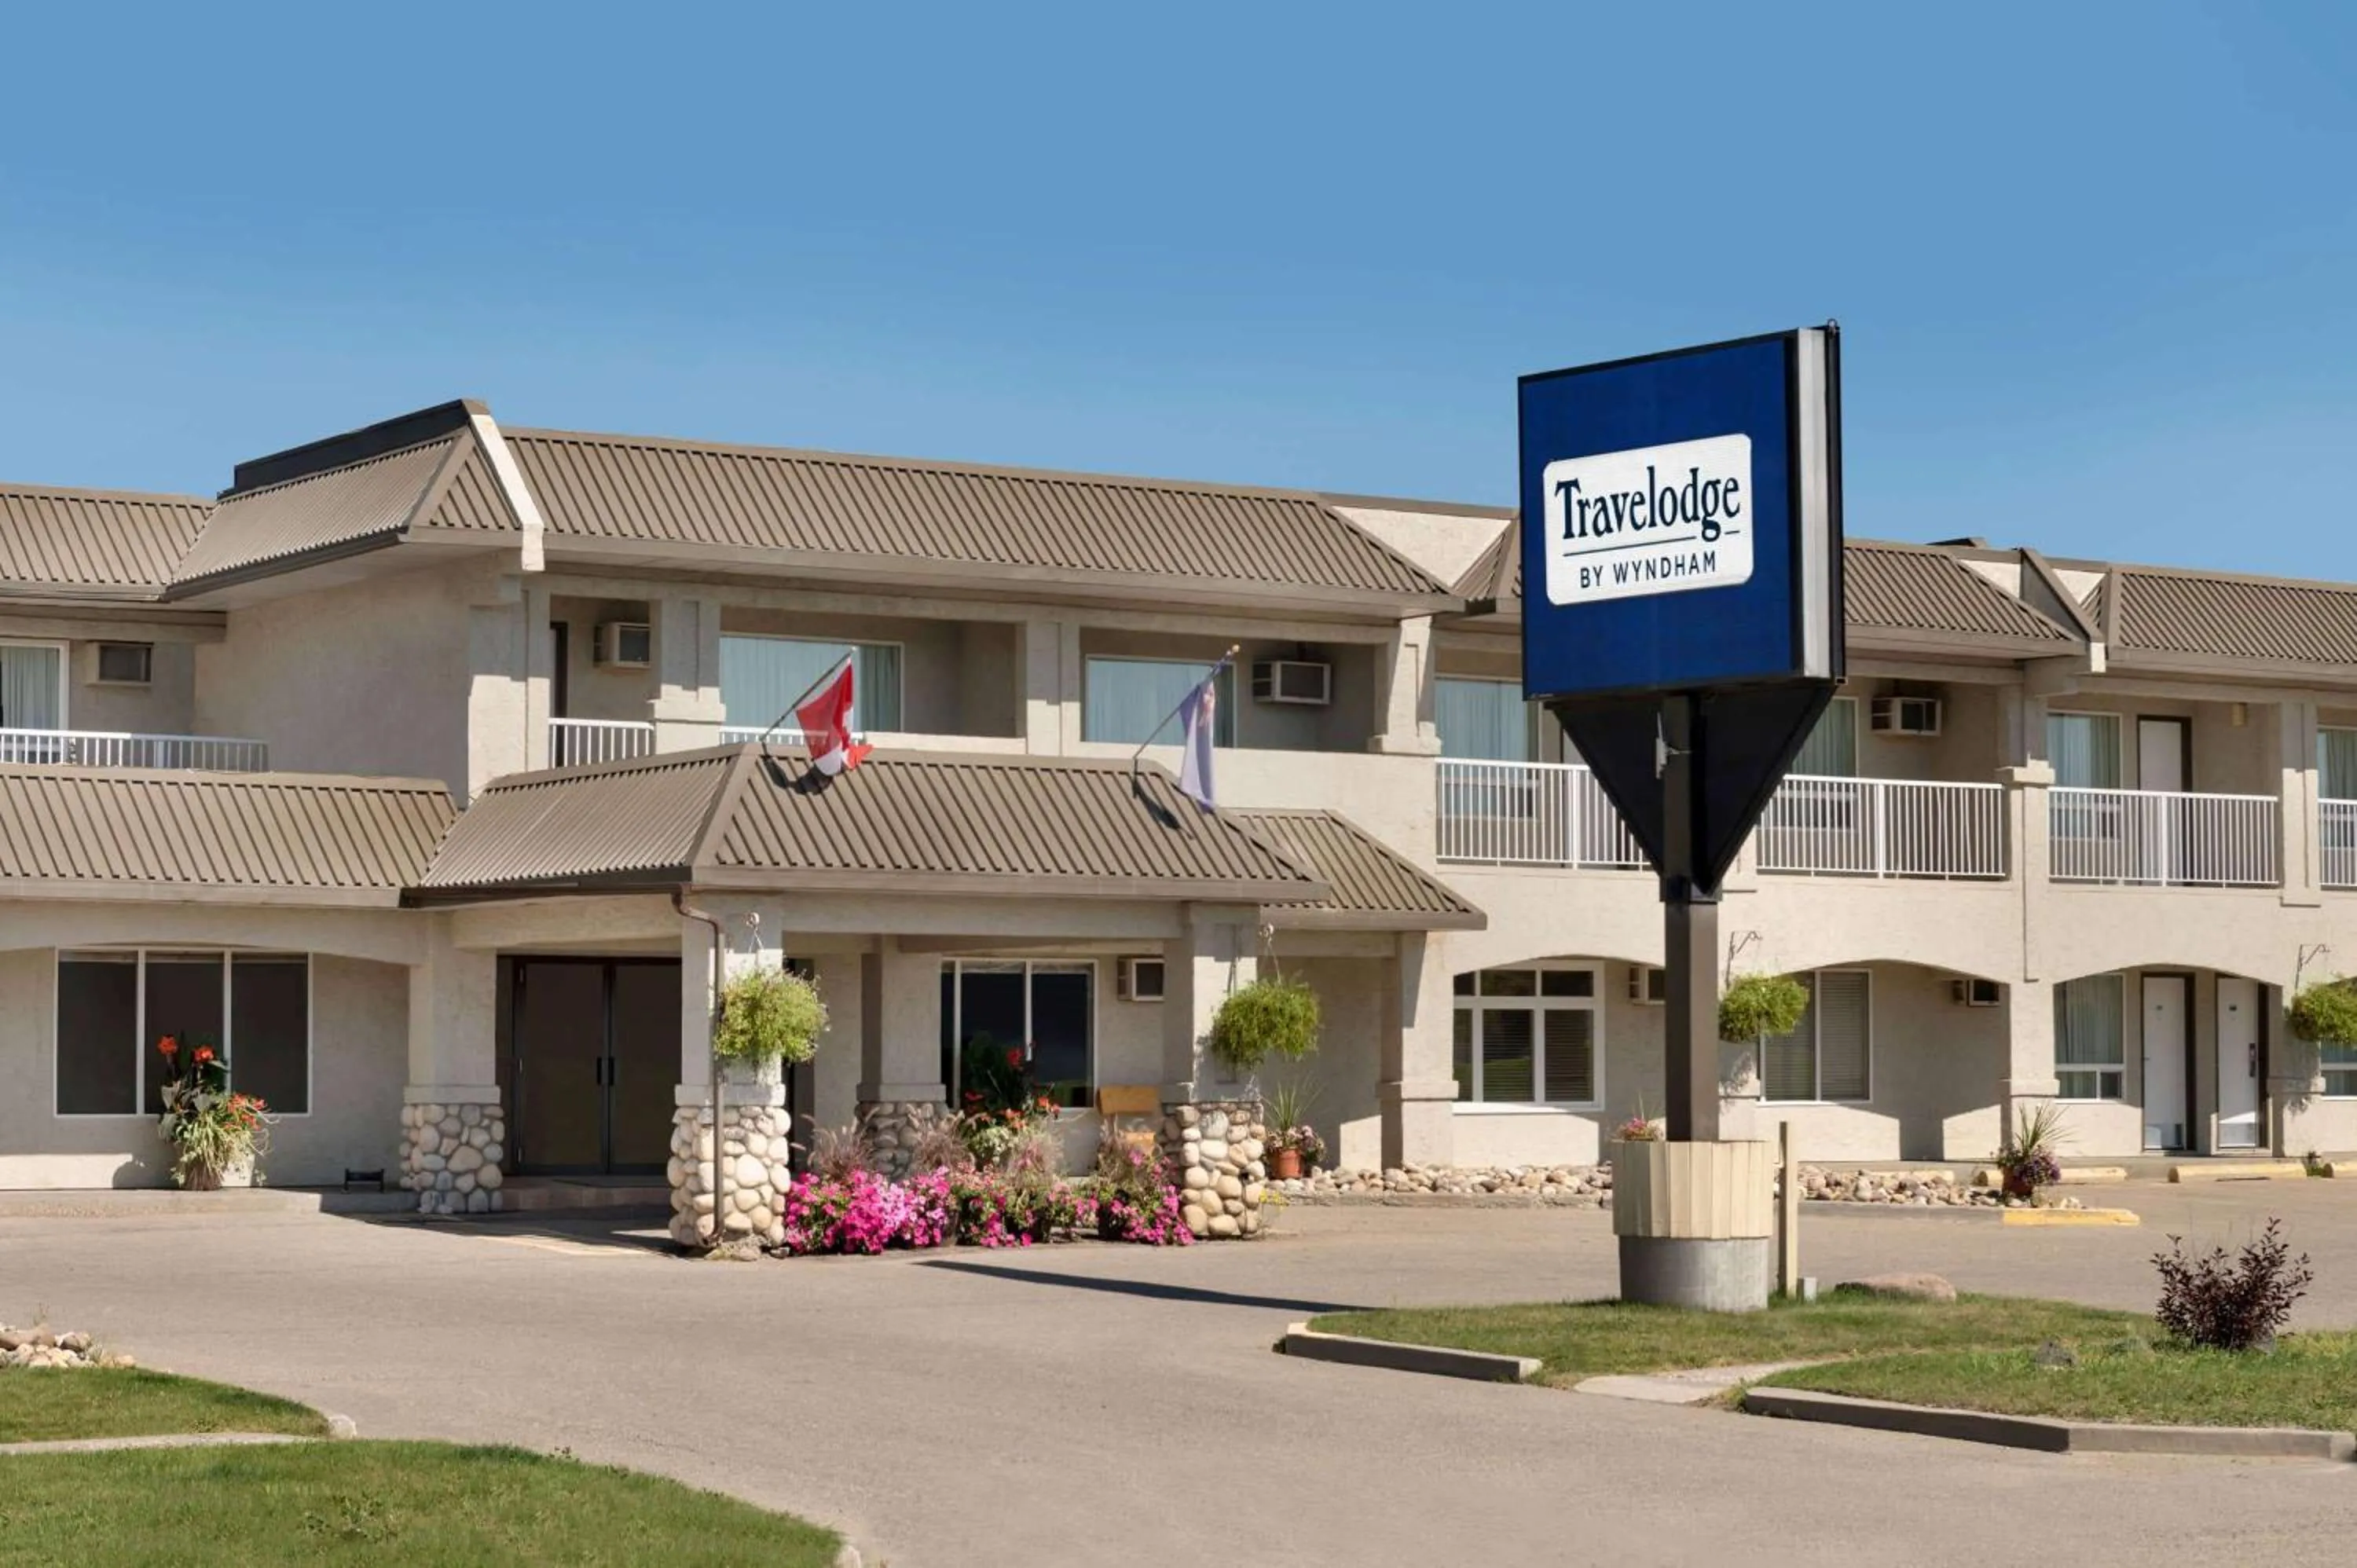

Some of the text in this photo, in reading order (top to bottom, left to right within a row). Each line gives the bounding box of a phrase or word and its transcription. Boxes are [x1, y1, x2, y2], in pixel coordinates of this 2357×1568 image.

[1554, 465, 1740, 542] Travelodge
[1580, 551, 1716, 588] BY WYNDHAM
